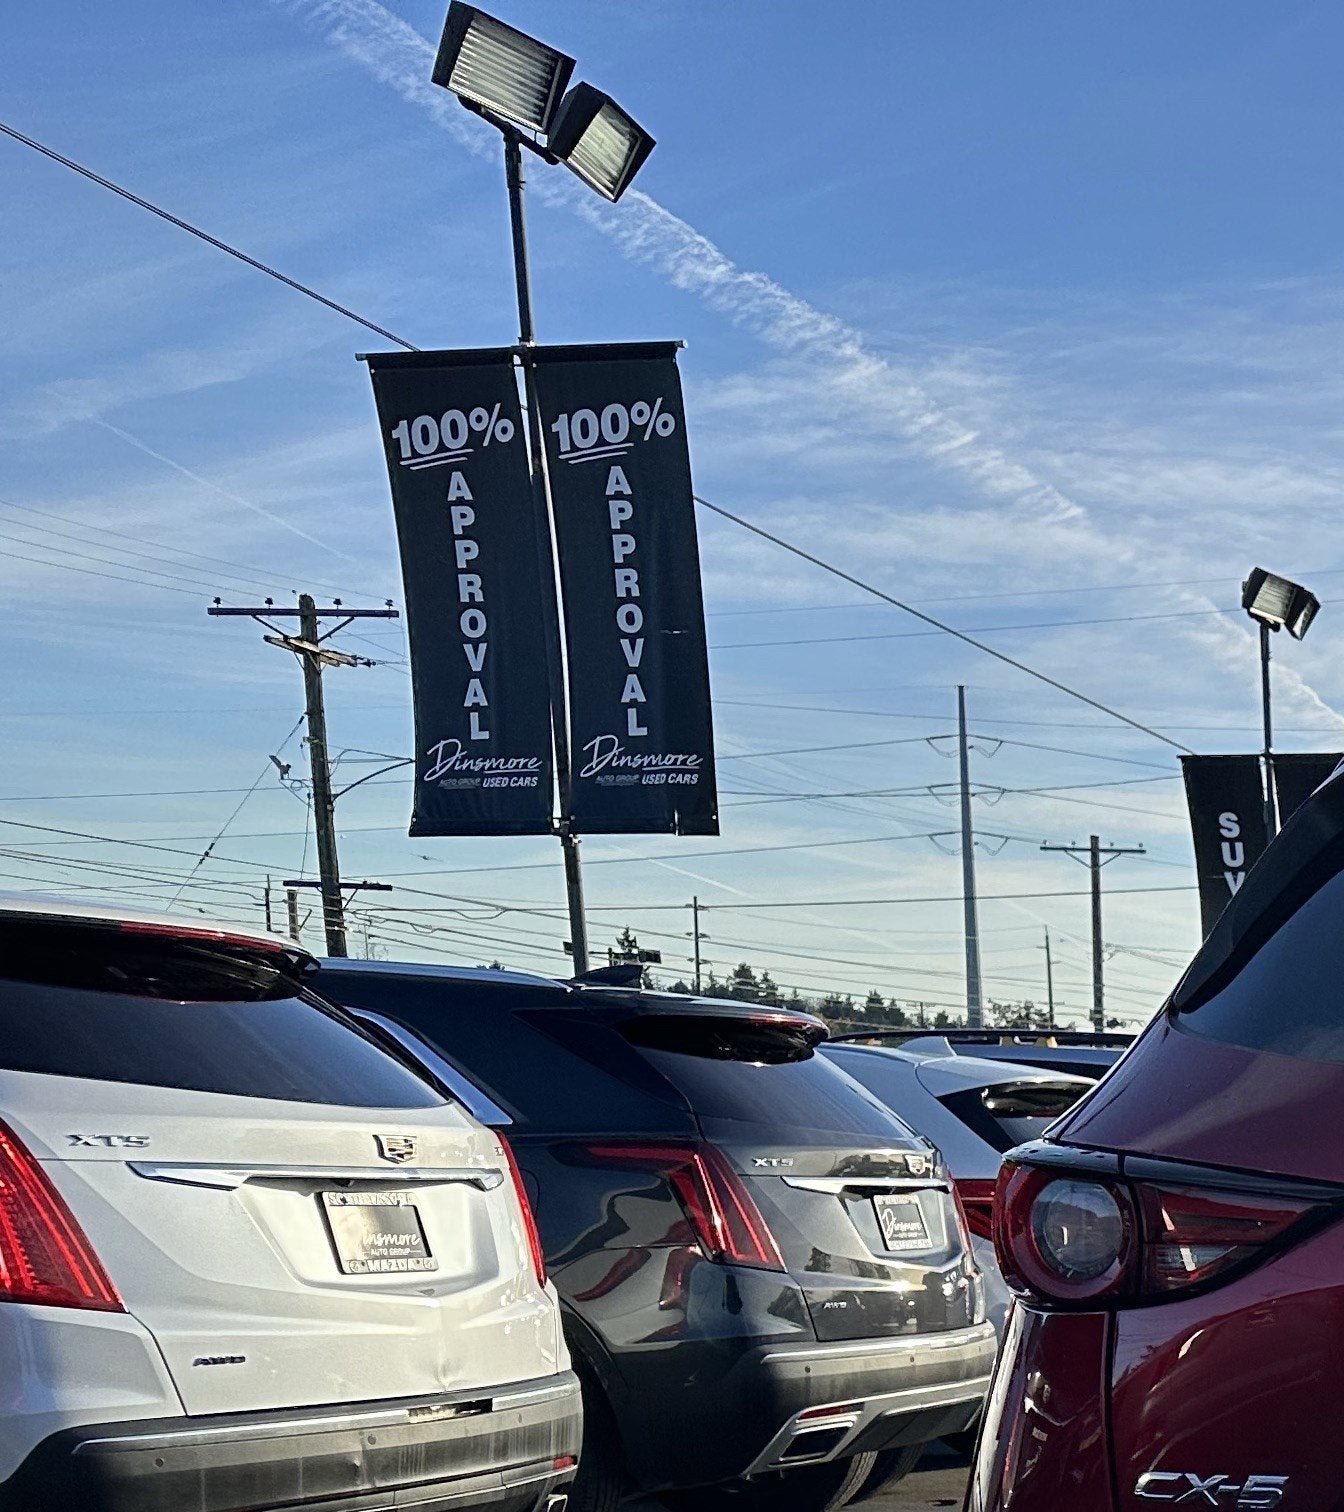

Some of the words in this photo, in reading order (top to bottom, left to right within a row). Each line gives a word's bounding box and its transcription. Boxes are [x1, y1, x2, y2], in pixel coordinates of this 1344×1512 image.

[392, 402, 515, 458] 100%
[552, 397, 676, 452] 100%
[447, 470, 490, 741] APPROVAL
[605, 465, 648, 737] APPROVAL
[423, 738, 543, 781] Dinsmore
[579, 734, 704, 778] Dinsmore
[482, 776, 508, 788] USED
[509, 776, 539, 787] CARS
[641, 773, 666, 785] USED
[667, 773, 699, 785] CARS
[65, 1133, 151, 1148] XT5
[752, 1157, 794, 1168] XT5
[1134, 1471, 1290, 1509] CX-5
